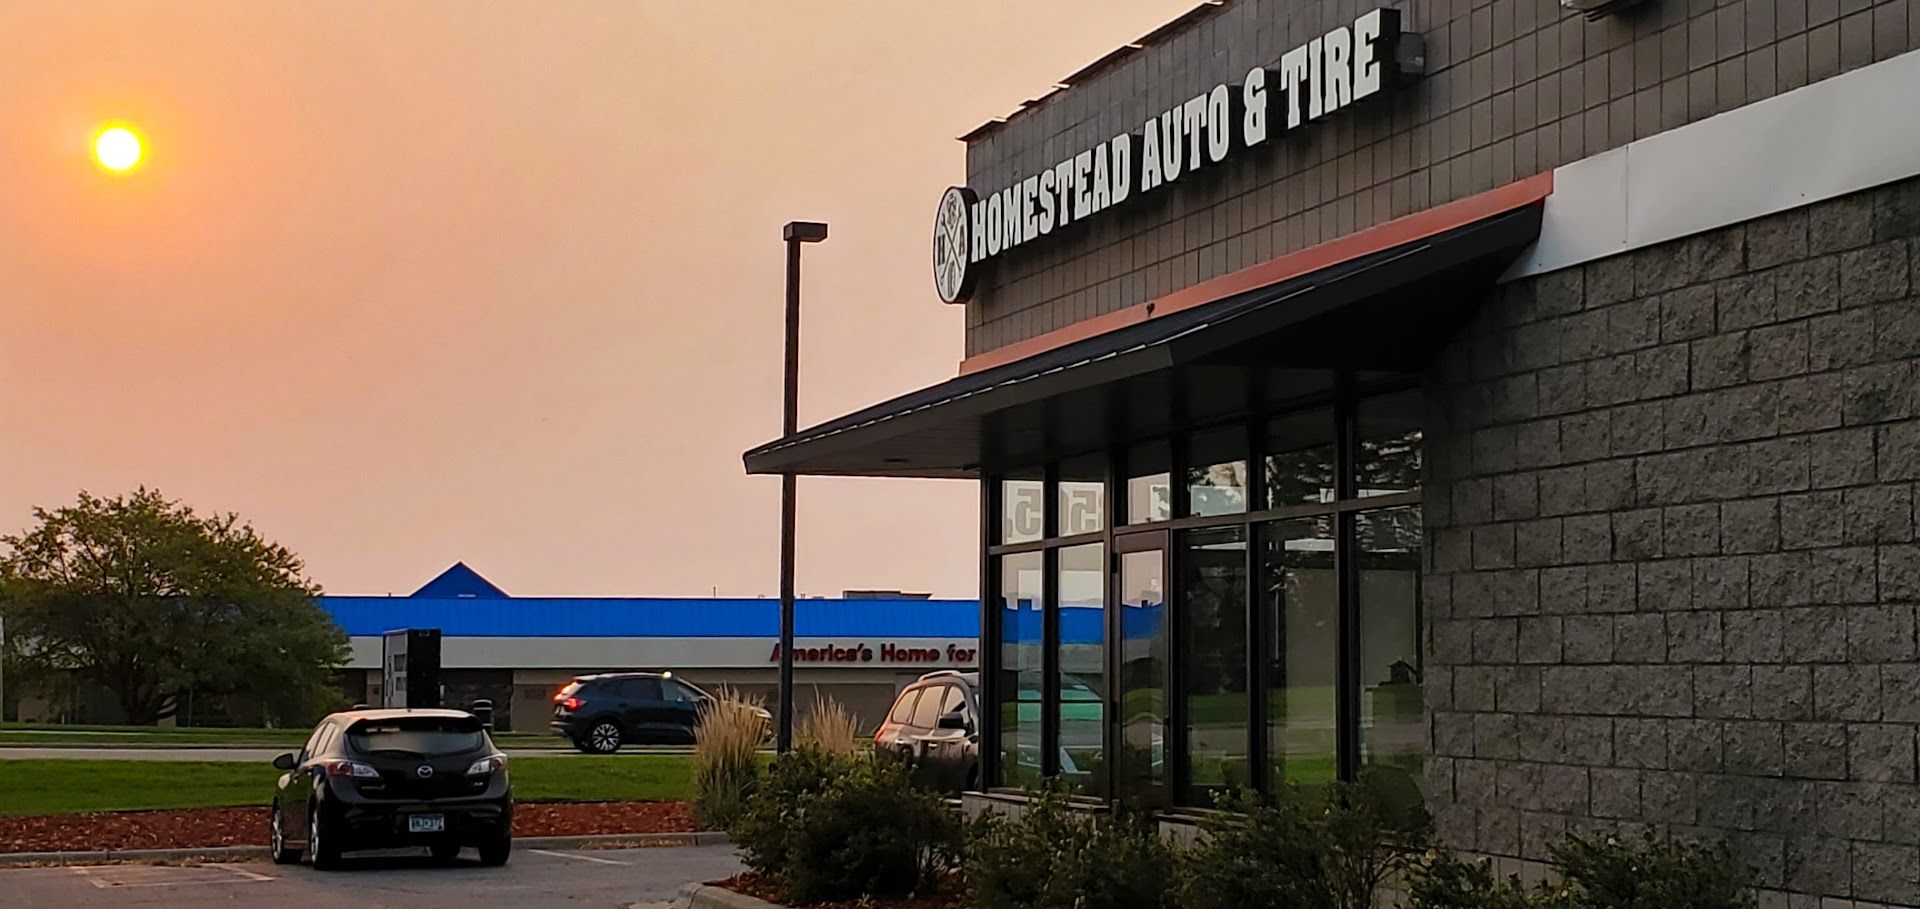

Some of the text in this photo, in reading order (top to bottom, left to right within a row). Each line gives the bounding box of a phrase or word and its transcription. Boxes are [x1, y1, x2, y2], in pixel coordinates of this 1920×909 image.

[971, 7, 1381, 263] HOMESTEAD AUTO & TIRE
[880, 643, 941, 662] Home
[947, 643, 977, 662] for
